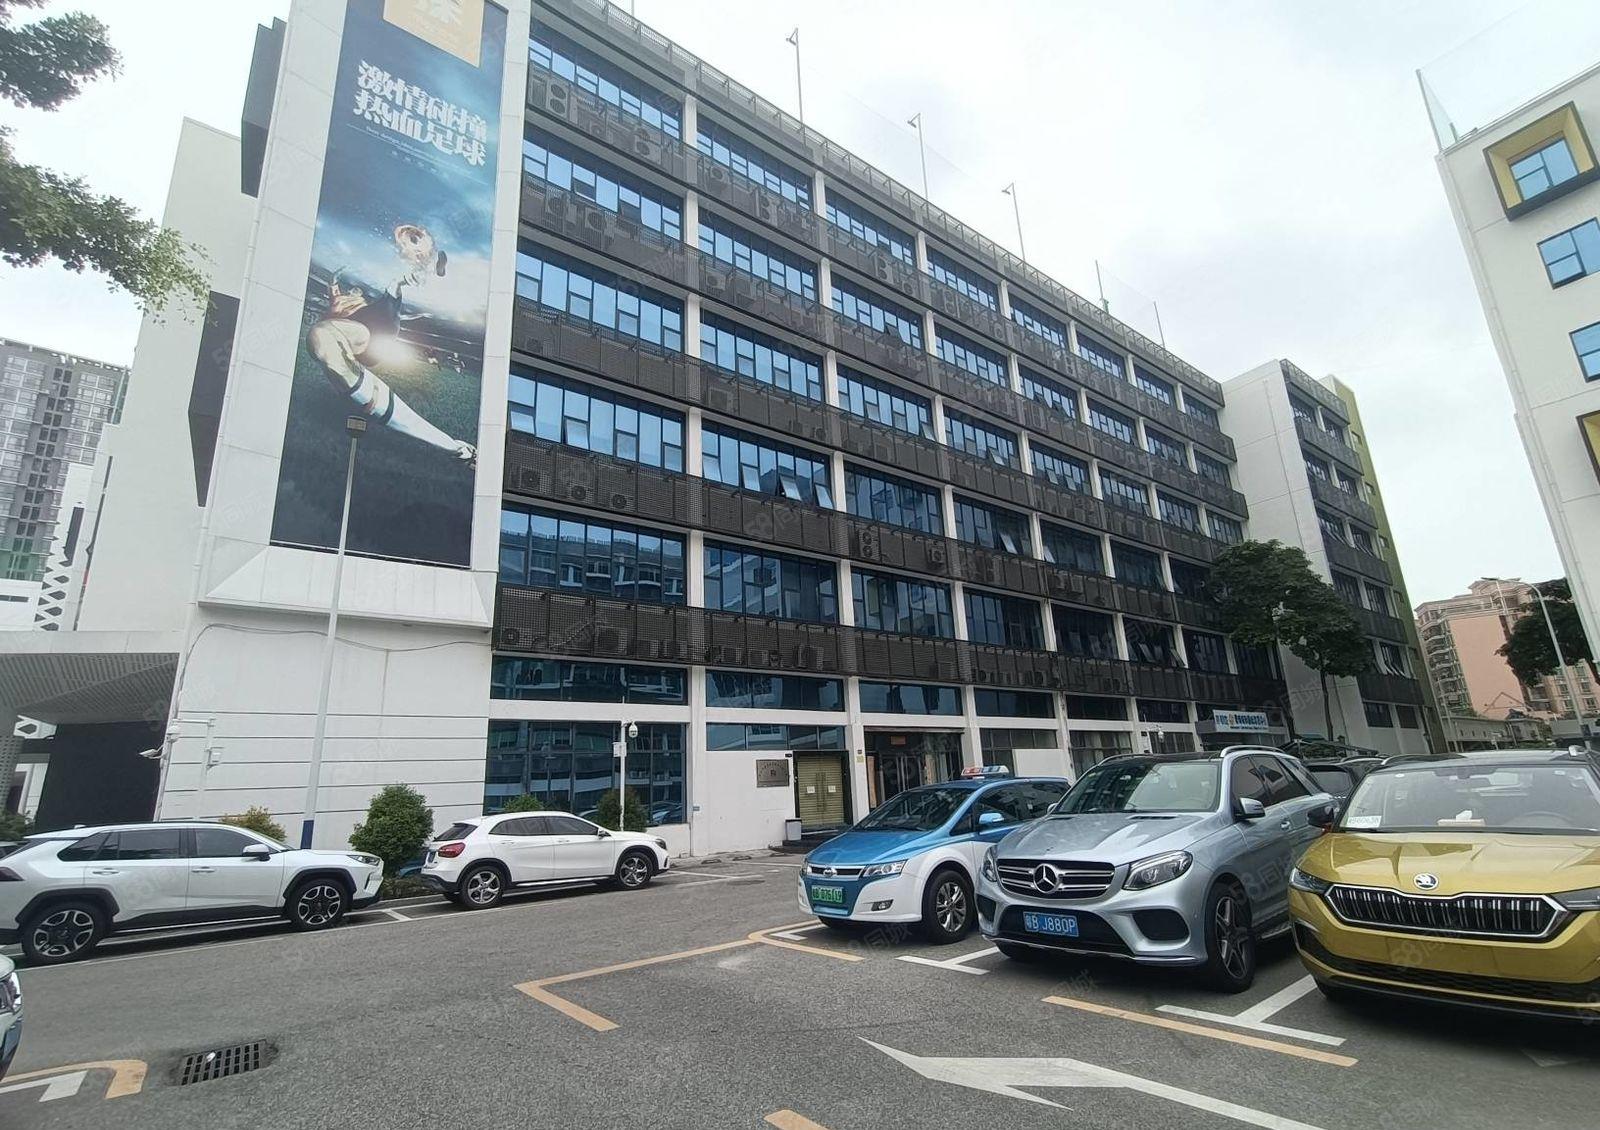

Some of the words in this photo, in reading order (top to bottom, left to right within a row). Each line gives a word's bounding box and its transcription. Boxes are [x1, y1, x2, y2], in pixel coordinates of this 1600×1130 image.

[353, 89, 487, 167] 热血足球
[357, 58, 487, 142] 激情碰撞
